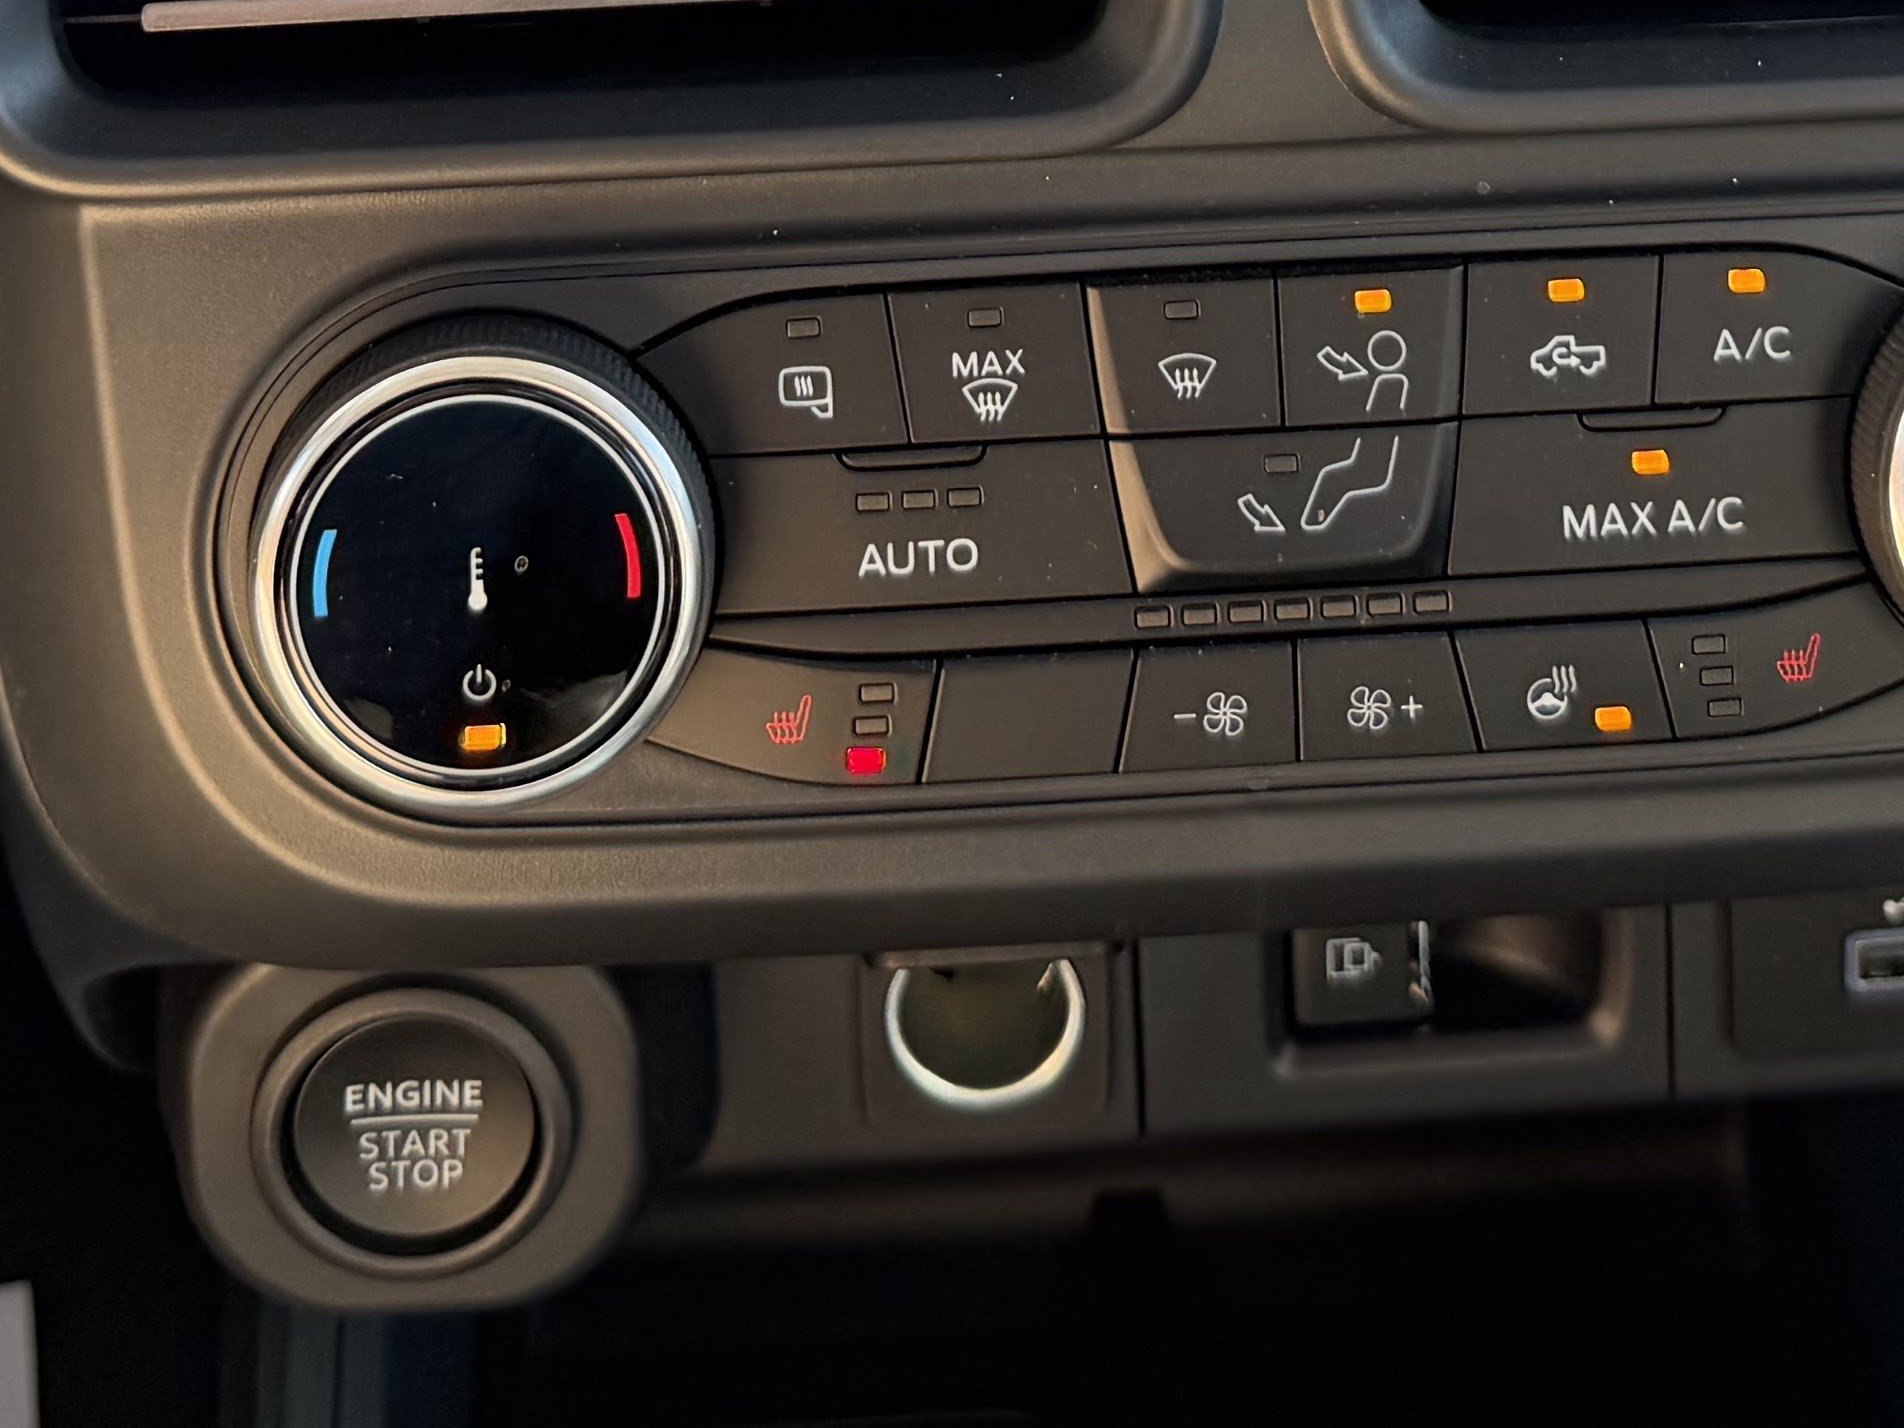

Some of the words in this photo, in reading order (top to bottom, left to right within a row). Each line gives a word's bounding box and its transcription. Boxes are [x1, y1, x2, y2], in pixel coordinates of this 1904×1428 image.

[1713, 327, 1791, 363] A/C
[951, 349, 1025, 380] MAX
[1563, 503, 1655, 539] MAX
[1666, 497, 1744, 535] A/C
[858, 539, 979, 577] AUTO
[344, 1079, 484, 1115] ENGINE
[358, 1129, 471, 1161] START
[367, 1158, 464, 1192] STOP
